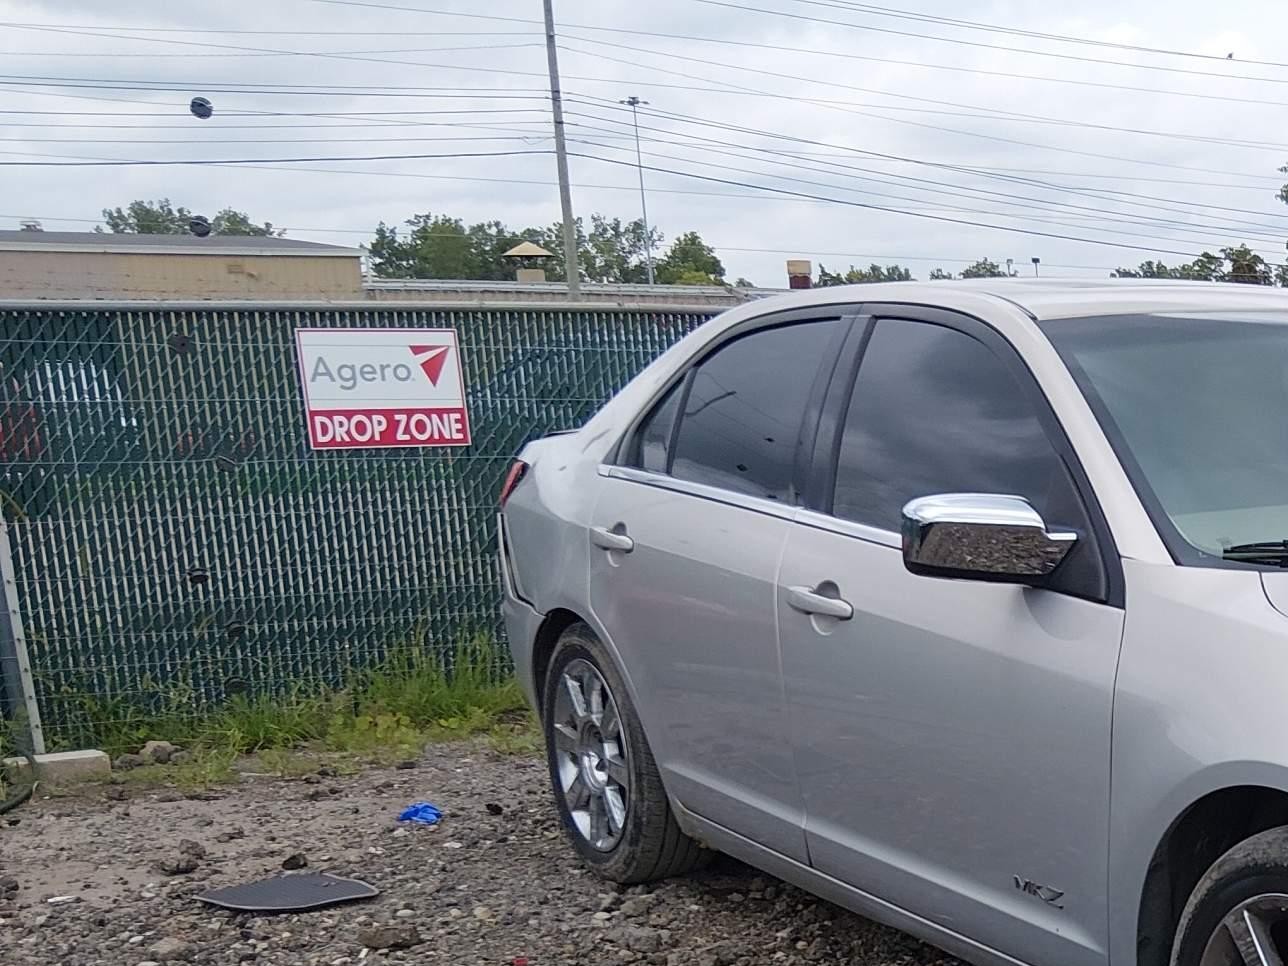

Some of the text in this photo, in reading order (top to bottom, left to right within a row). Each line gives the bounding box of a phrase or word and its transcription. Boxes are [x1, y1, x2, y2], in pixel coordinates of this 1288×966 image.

[310, 356, 412, 390] Agero
[314, 413, 464, 442] DROP ZONE
